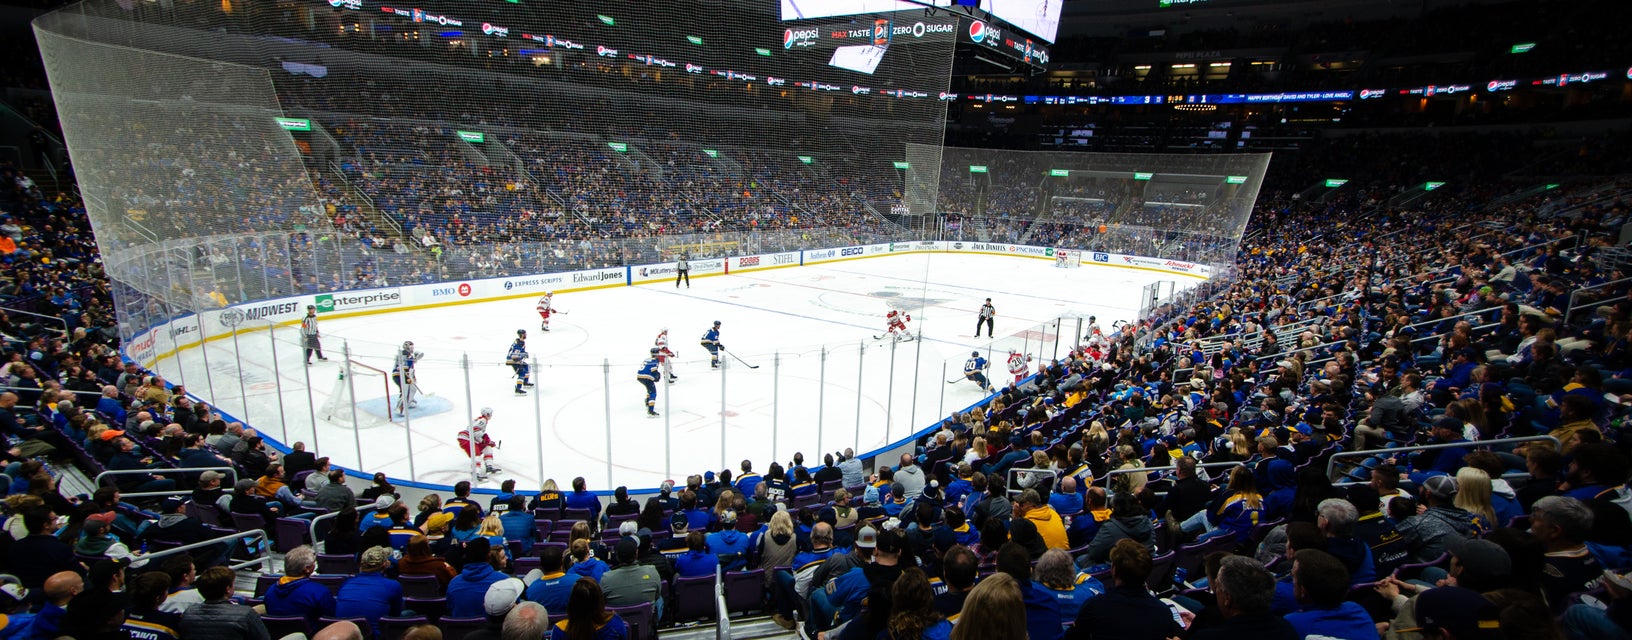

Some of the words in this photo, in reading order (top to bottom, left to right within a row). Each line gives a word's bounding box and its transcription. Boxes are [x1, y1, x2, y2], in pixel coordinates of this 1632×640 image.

[793, 27, 819, 42] pepsi
[831, 31, 847, 39] MAX
[848, 28, 870, 38] TASTE
[892, 26, 912, 35] ZERO
[926, 24, 953, 33] SUGAR
[985, 26, 1001, 40] pepsi
[1014, 41, 1025, 53] TASTE
[1497, 80, 1516, 88] pepsi
[1144, 95, 1151, 104] 3
[1200, 94, 1207, 103] 1
[841, 247, 864, 256] GEICO
[740, 256, 760, 265] DOBBS
[773, 253, 795, 265] STIFEL
[514, 279, 539, 288] EXPRESS
[541, 277, 562, 285] SCRIPTS
[432, 287, 456, 297] BMO
[317, 292, 400, 308] enterprise
[245, 302, 298, 321] MIDWEST
